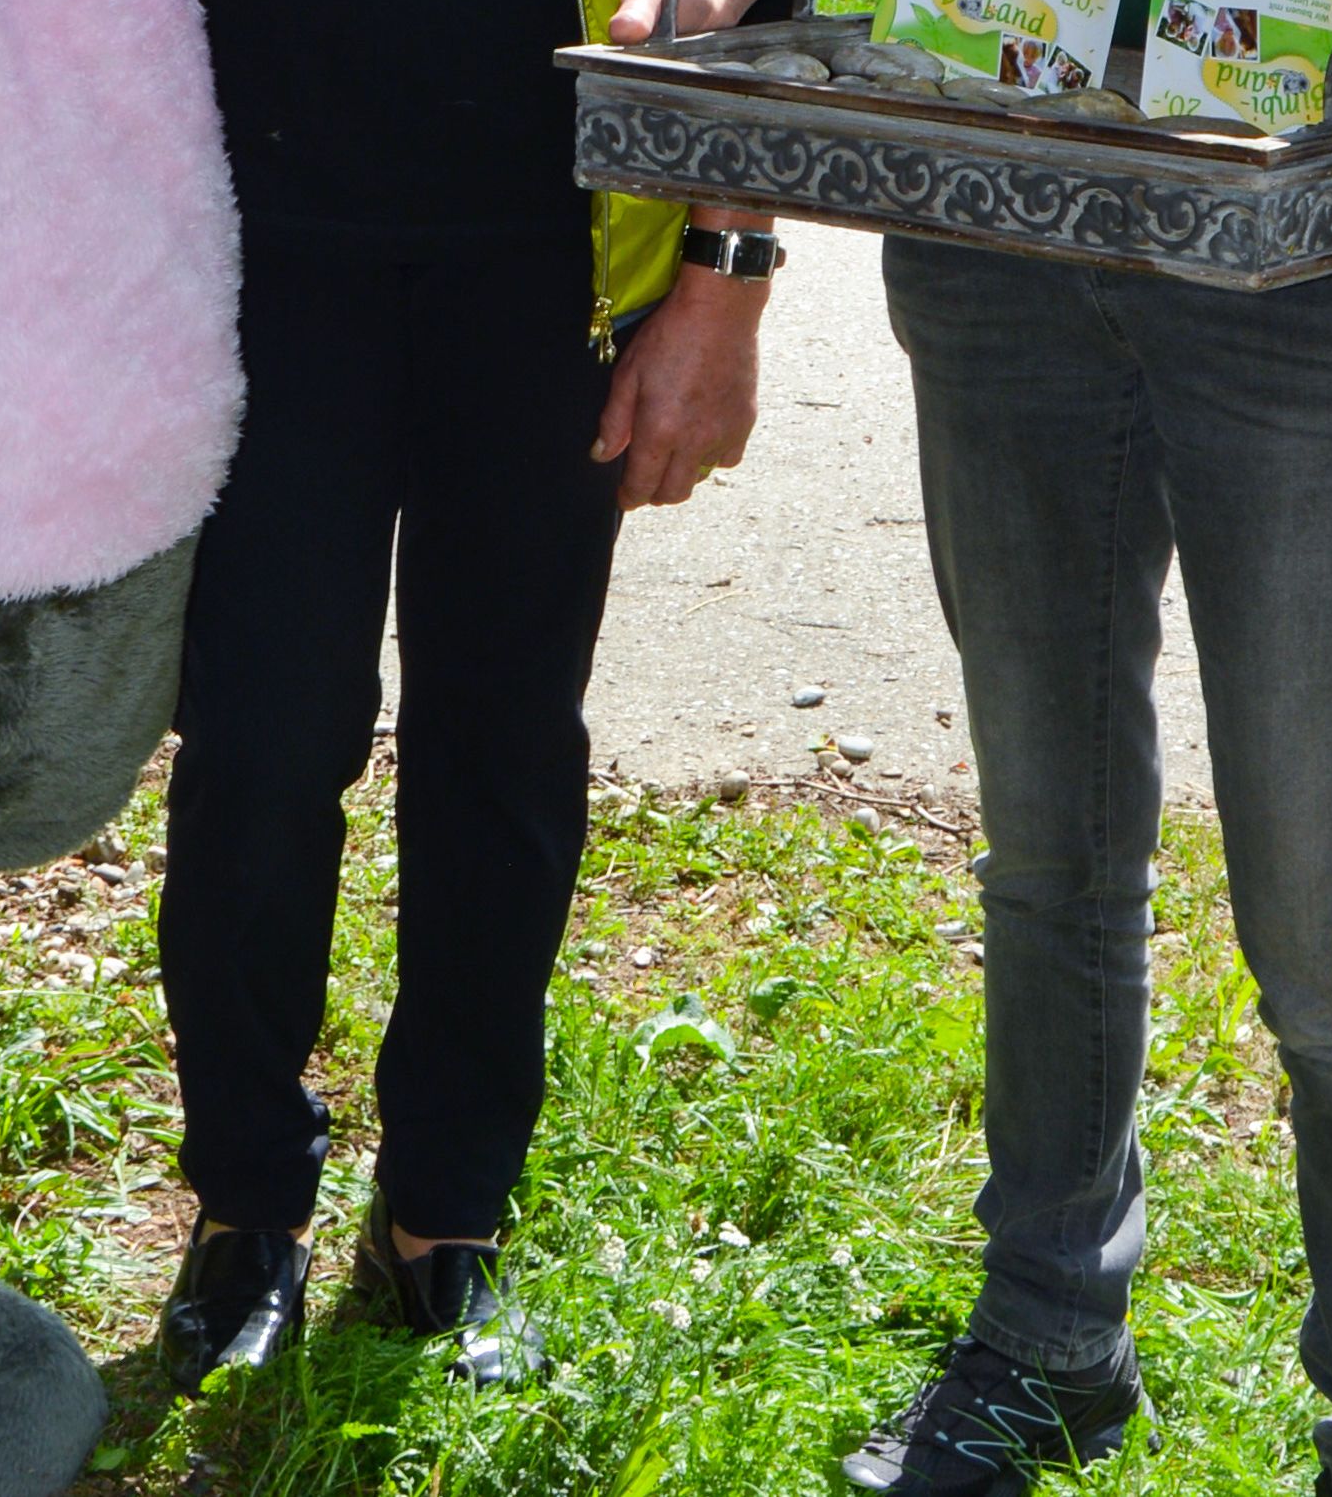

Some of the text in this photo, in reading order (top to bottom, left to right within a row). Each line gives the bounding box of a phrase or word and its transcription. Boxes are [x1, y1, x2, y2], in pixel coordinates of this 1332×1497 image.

[1268, 3, 1283, 13] mit
[1314, 11, 1330, 23] Wir
[1216, 62, 1282, 95] Land
